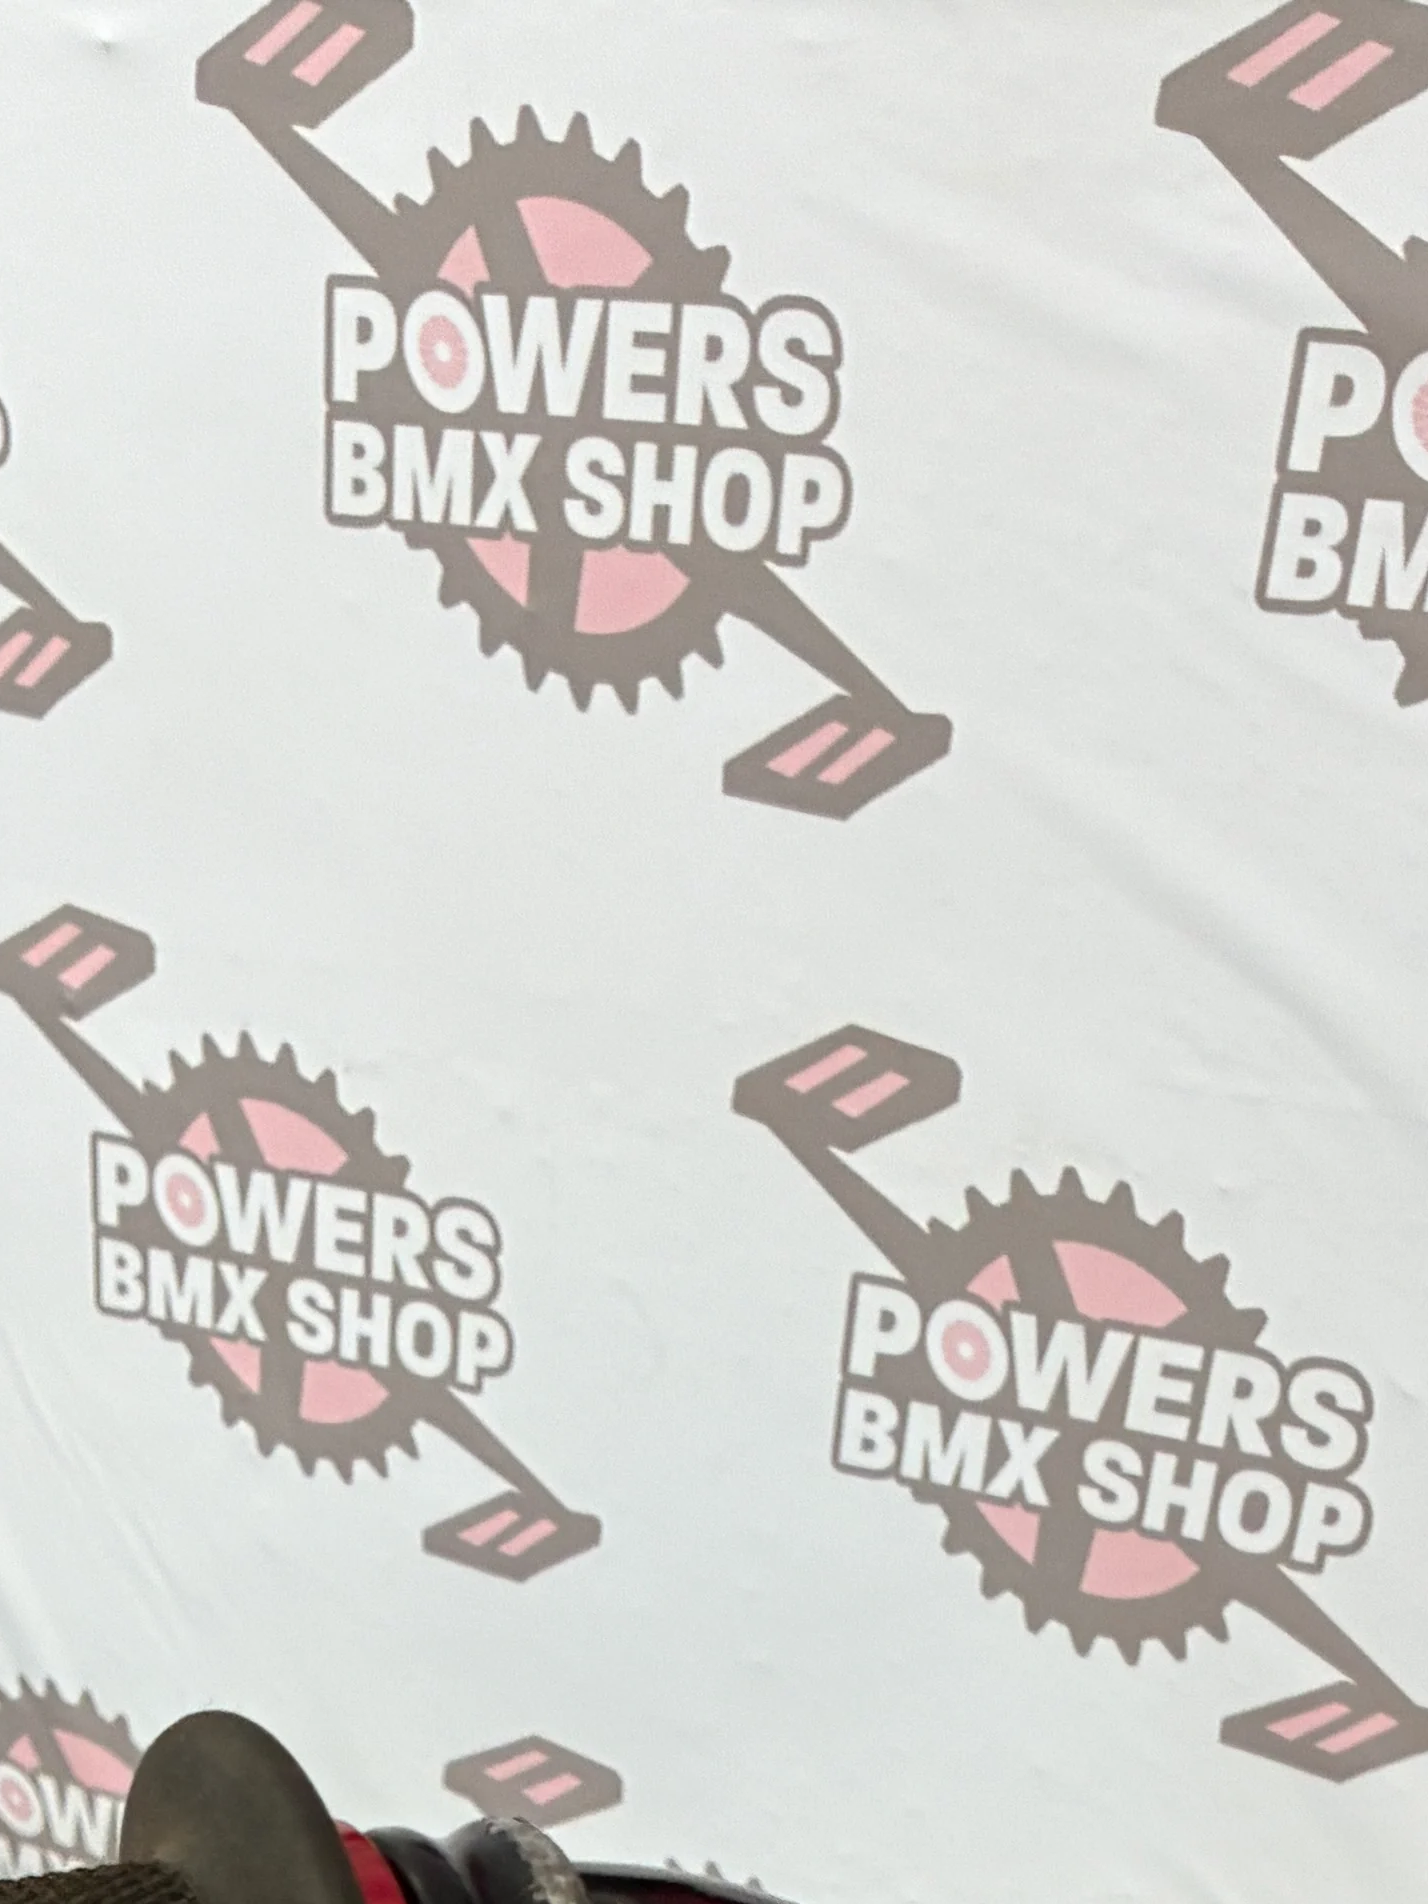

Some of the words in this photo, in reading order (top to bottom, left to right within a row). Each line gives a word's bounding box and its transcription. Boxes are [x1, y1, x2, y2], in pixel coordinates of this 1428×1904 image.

[331, 285, 836, 437] POWERS
[331, 419, 543, 533] BMX
[563, 435, 846, 557] SHOP
[97, 1138, 499, 1302] POWERS
[99, 1236, 269, 1341] BMX
[285, 1277, 510, 1386] SHOP
[848, 1281, 1367, 1471] POWERS
[837, 1388, 1060, 1507] BMX
[1076, 1438, 1365, 1566] SHOP
